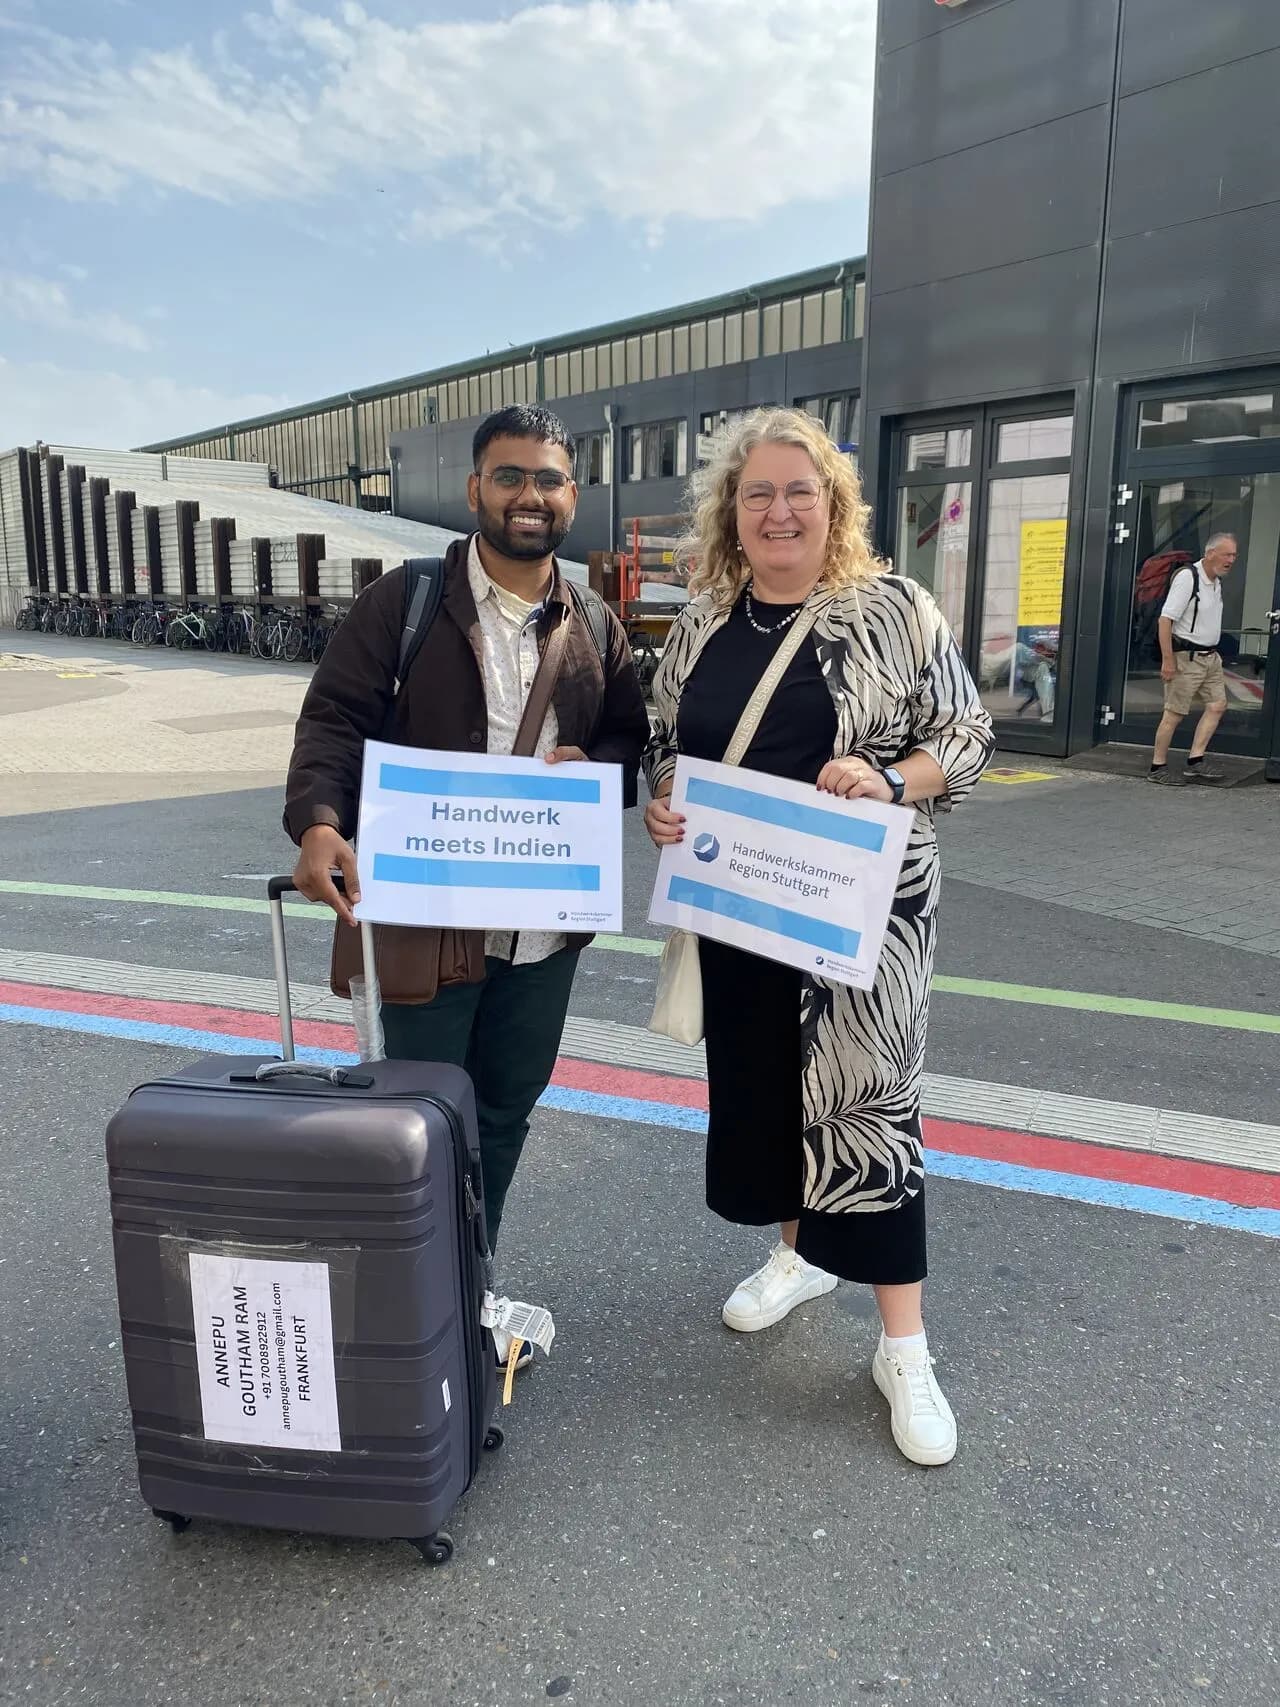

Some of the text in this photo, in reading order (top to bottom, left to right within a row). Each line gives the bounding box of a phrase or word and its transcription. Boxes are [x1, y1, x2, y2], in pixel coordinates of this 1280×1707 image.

[406, 836, 571, 858] meets Indien
[431, 801, 561, 825] Handwerk
[728, 858, 830, 899] Region Stuttgart
[732, 841, 856, 887] Handwerkskammer
[211, 1316, 231, 1388] ANNEPU
[233, 1286, 256, 1417] GOUTHAM RAM
[256, 1311, 272, 1400] +91 7008922912
[272, 1282, 292, 1431] annepugoutham@gmail.com
[293, 1315, 311, 1402] FRANKFURT
